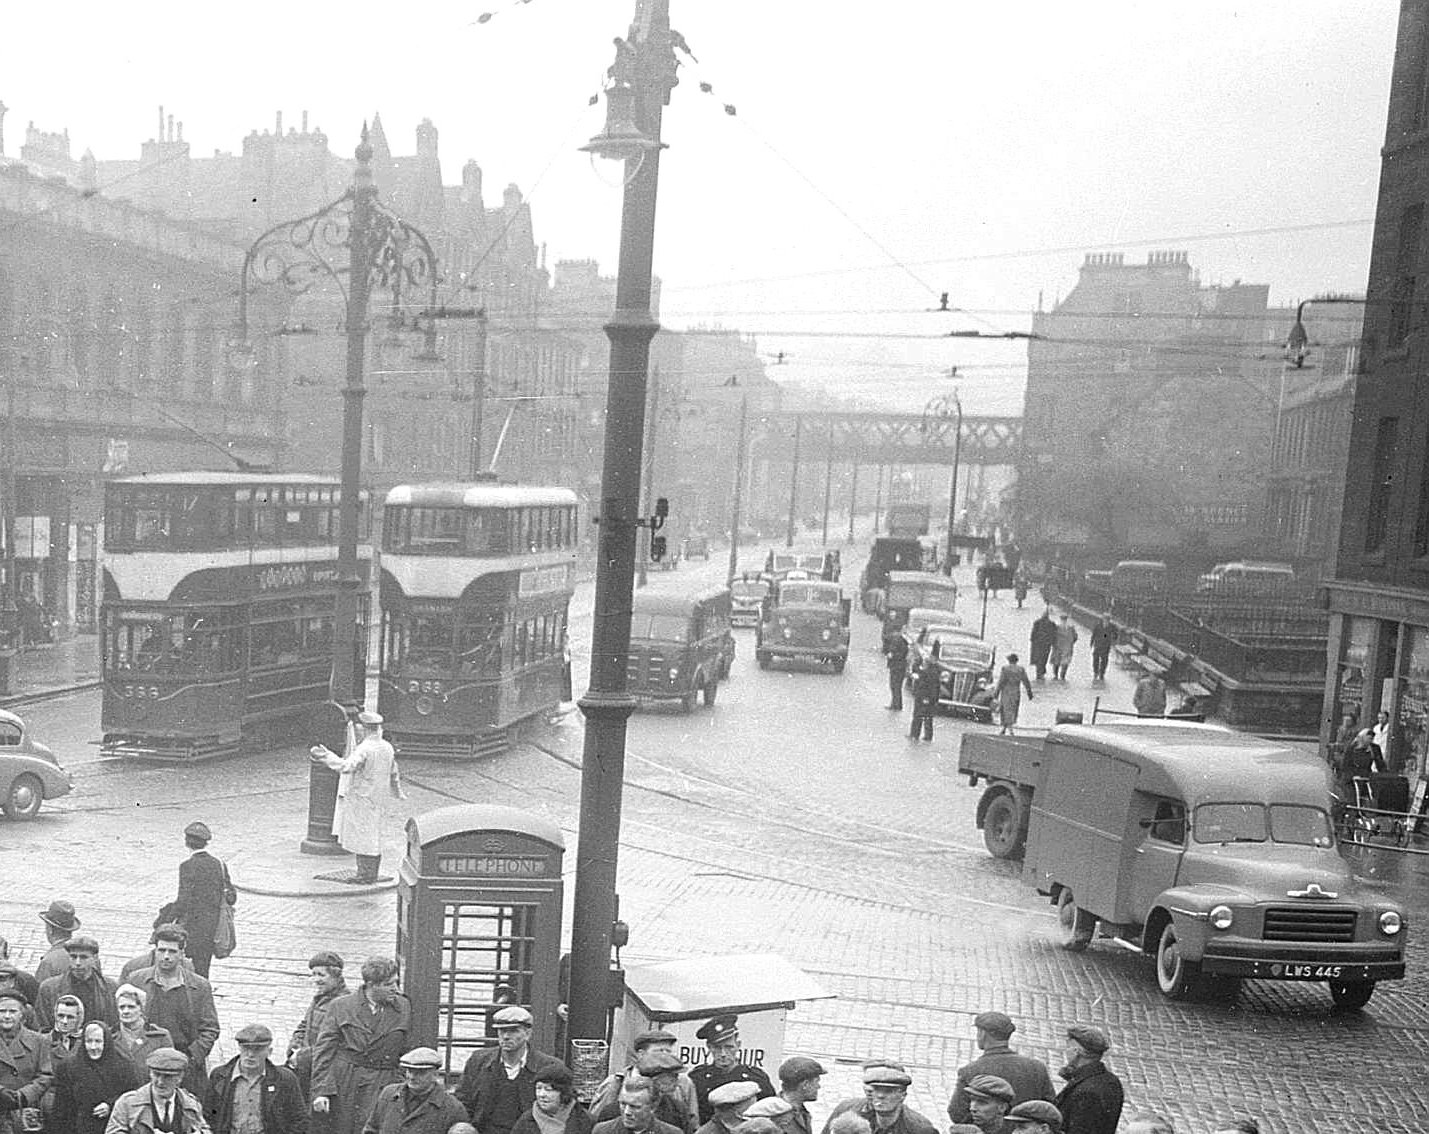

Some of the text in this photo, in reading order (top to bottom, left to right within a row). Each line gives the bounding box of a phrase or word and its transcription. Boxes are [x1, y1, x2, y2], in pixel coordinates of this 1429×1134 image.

[443, 858, 541, 873] TELEPHONE
[1315, 966, 1342, 978] 445
[680, 1046, 764, 1067] BUY OUR
